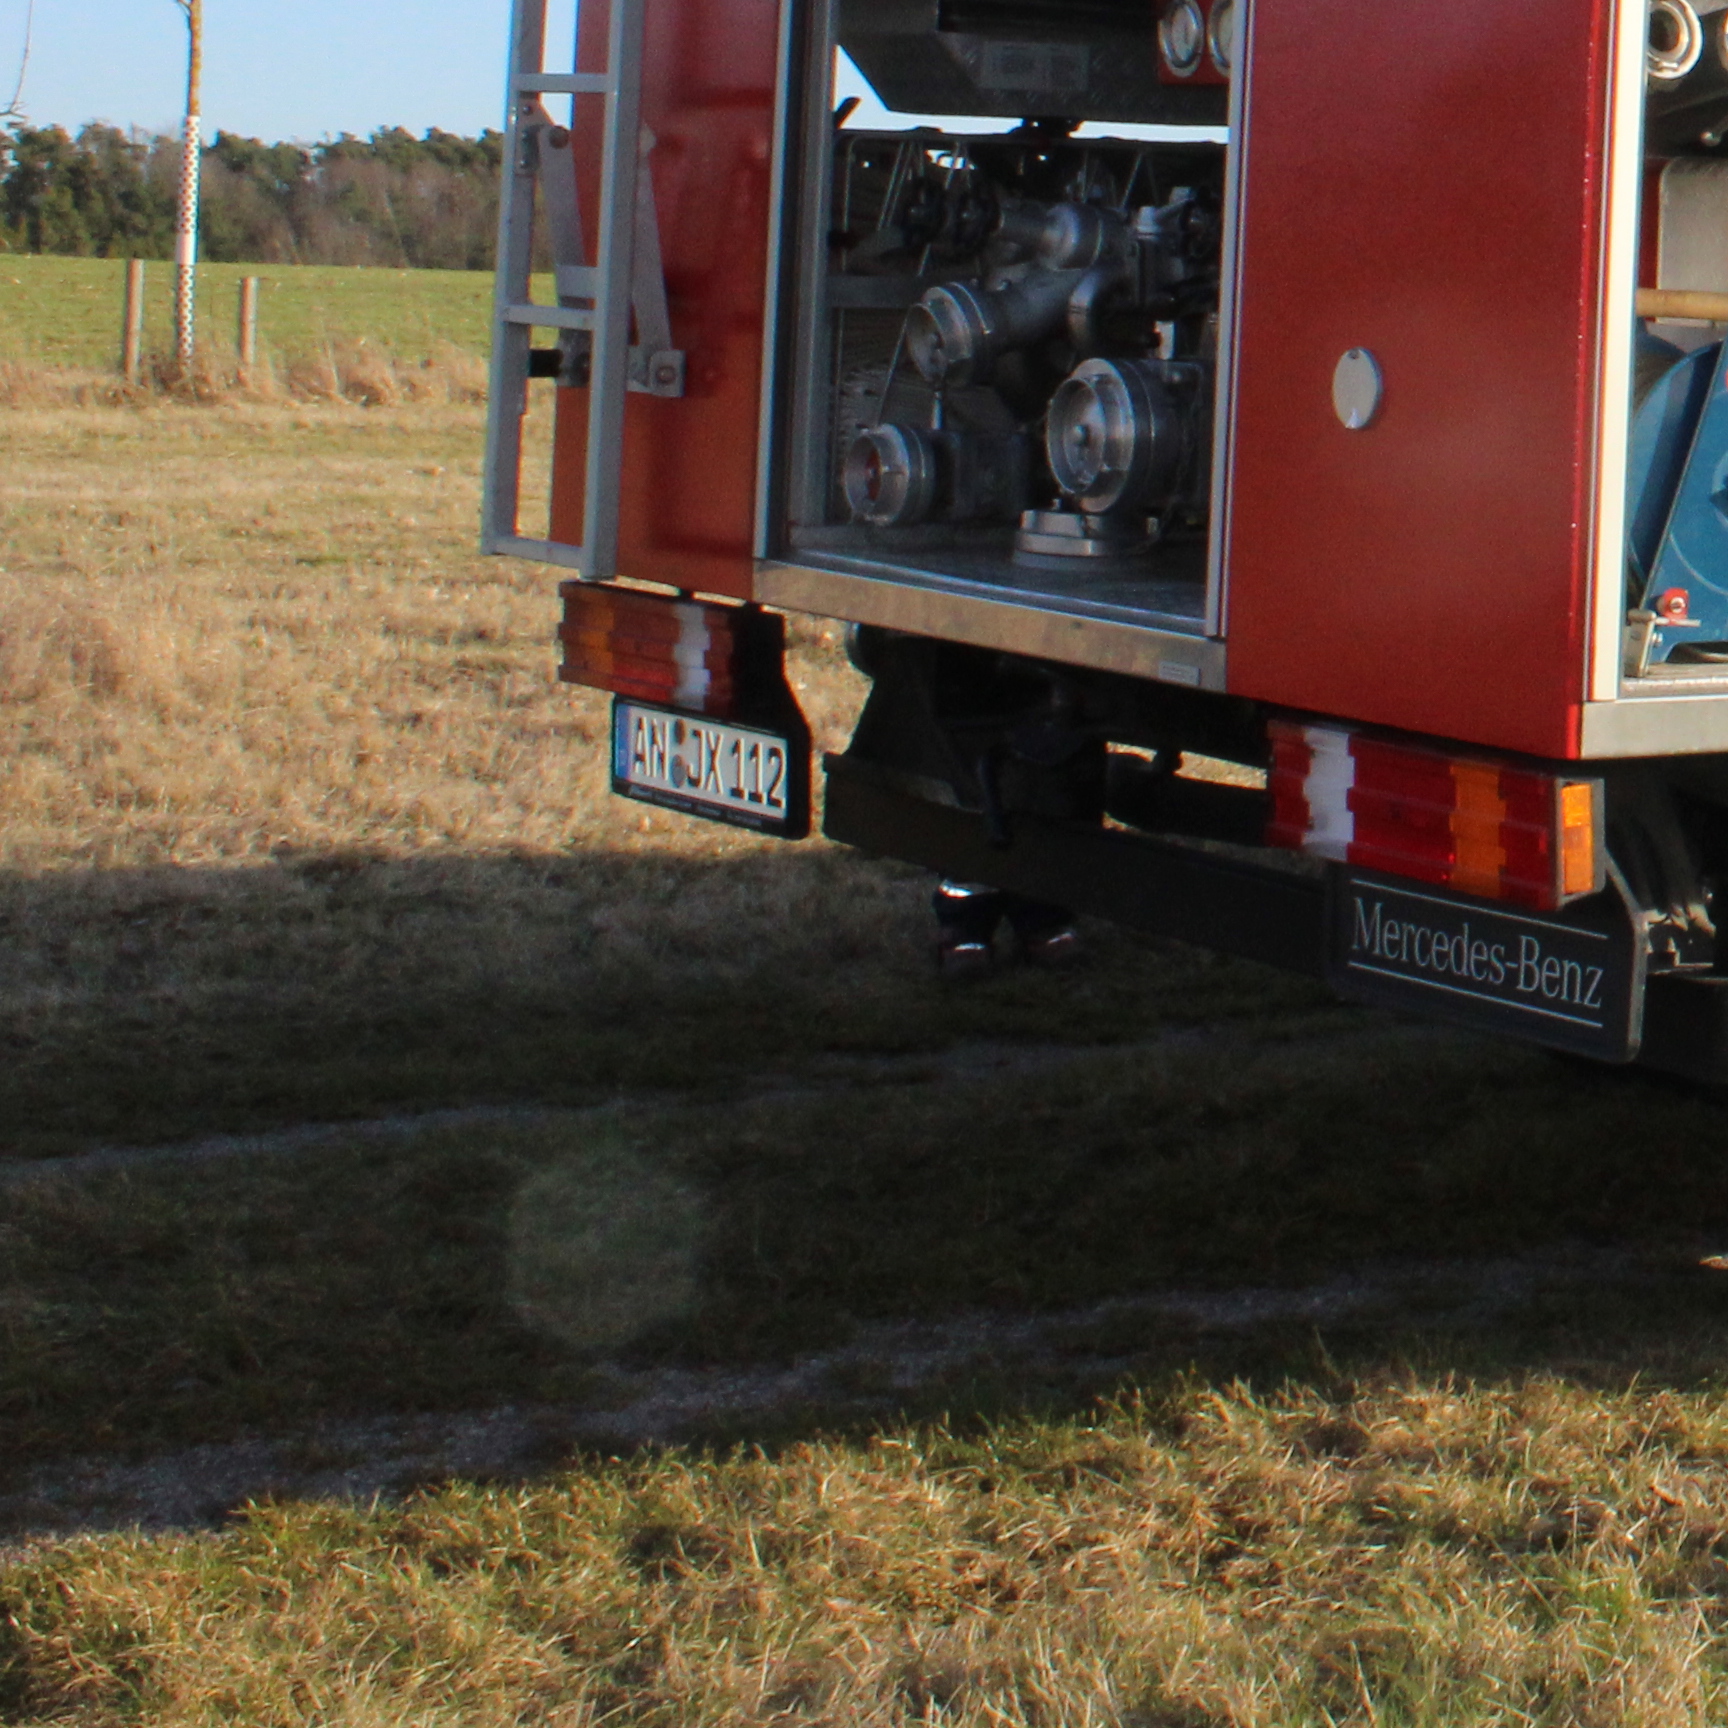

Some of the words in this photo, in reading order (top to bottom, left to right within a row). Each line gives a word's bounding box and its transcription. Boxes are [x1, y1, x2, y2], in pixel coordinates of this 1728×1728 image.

[633, 716, 669, 781] AN
[688, 728, 724, 795] JX
[731, 737, 786, 809] 112
[1351, 896, 1605, 1010] Mercedes-Benz
